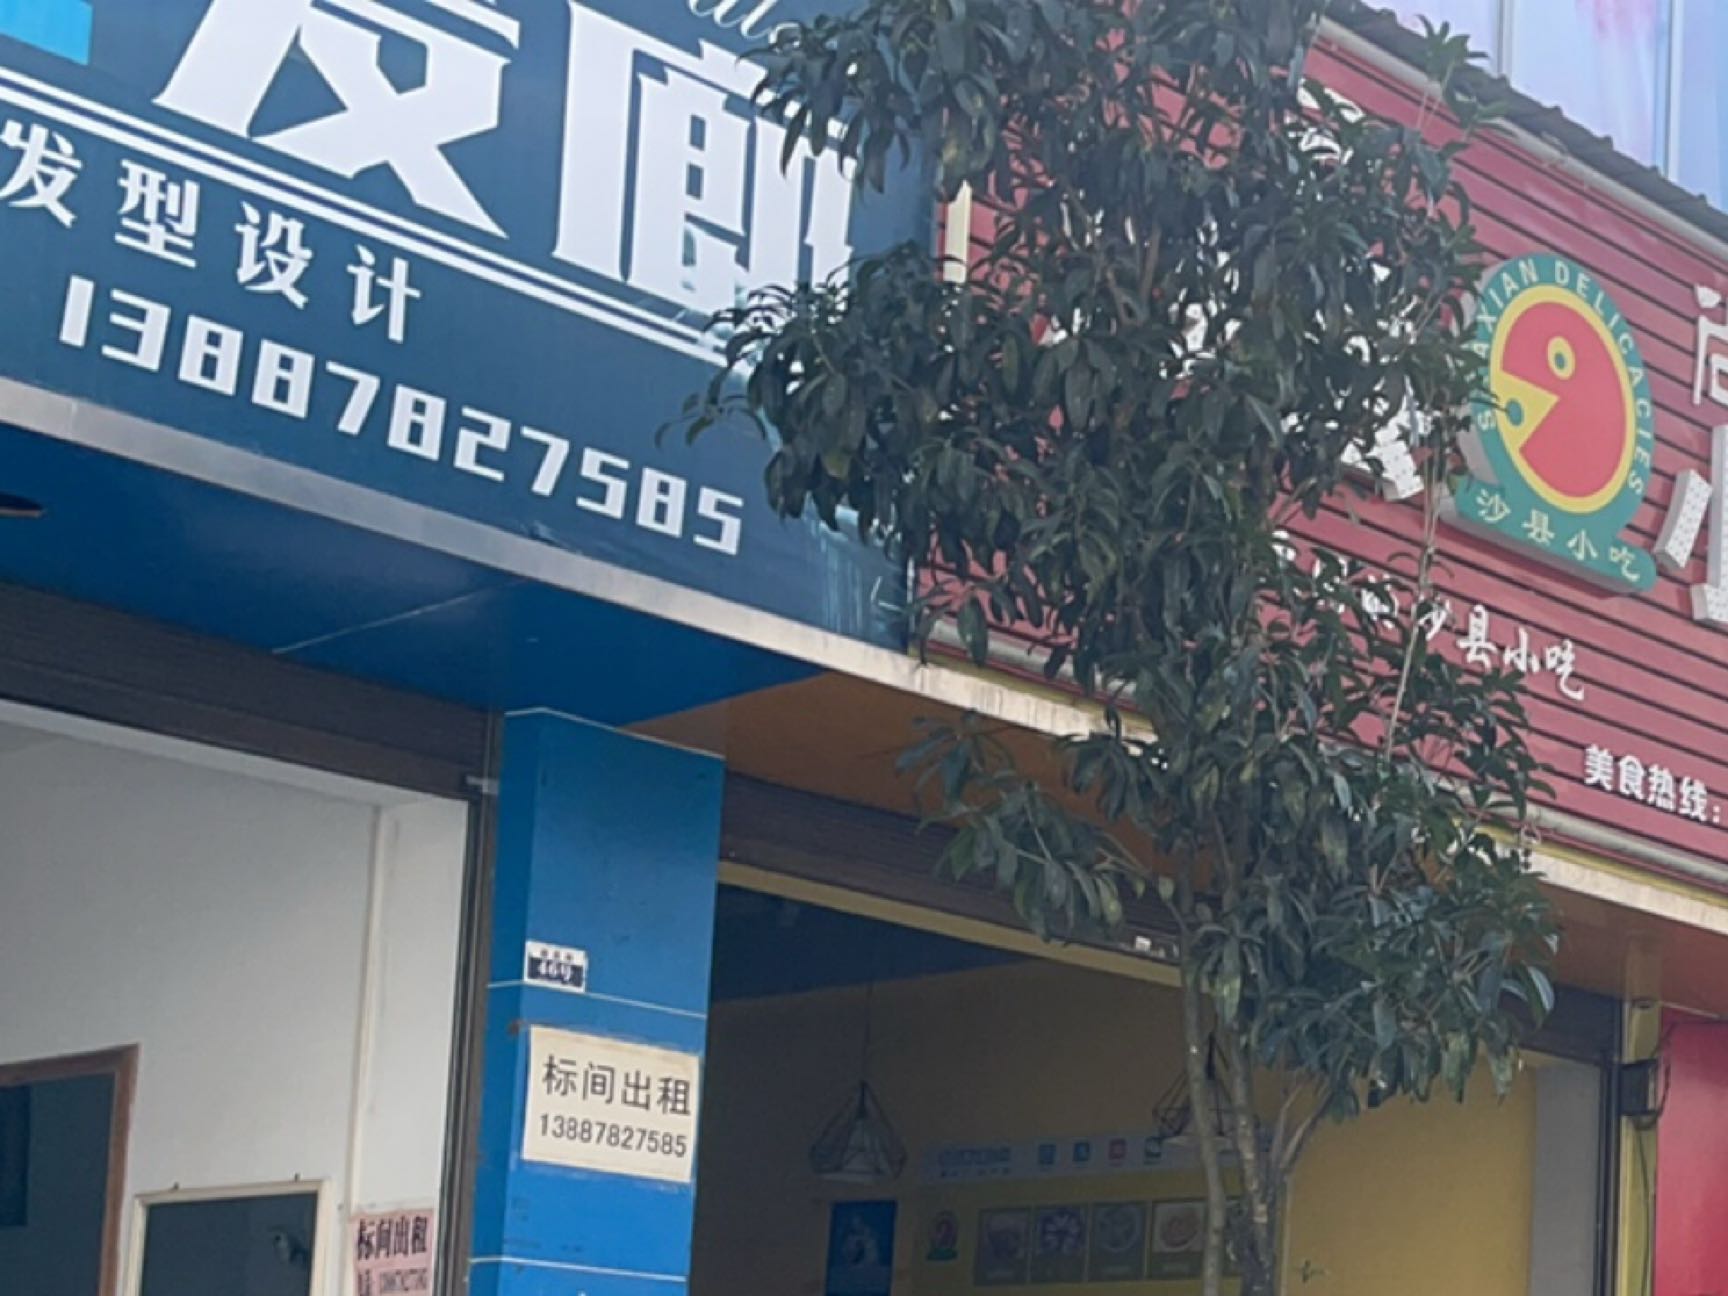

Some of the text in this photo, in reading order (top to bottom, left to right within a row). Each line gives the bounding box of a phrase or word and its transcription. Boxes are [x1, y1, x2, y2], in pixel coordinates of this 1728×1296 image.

[0, 118, 421, 343] 发型设计
[59, 275, 744, 556] 13887827585
[1554, 259, 1652, 495] DELICACIES
[1476, 488, 1642, 583] 沙县小吃
[541, 1055, 691, 1117] 标间出租
[537, 1112, 687, 1159] 13887827585
[357, 1215, 428, 1261] 标间出租
